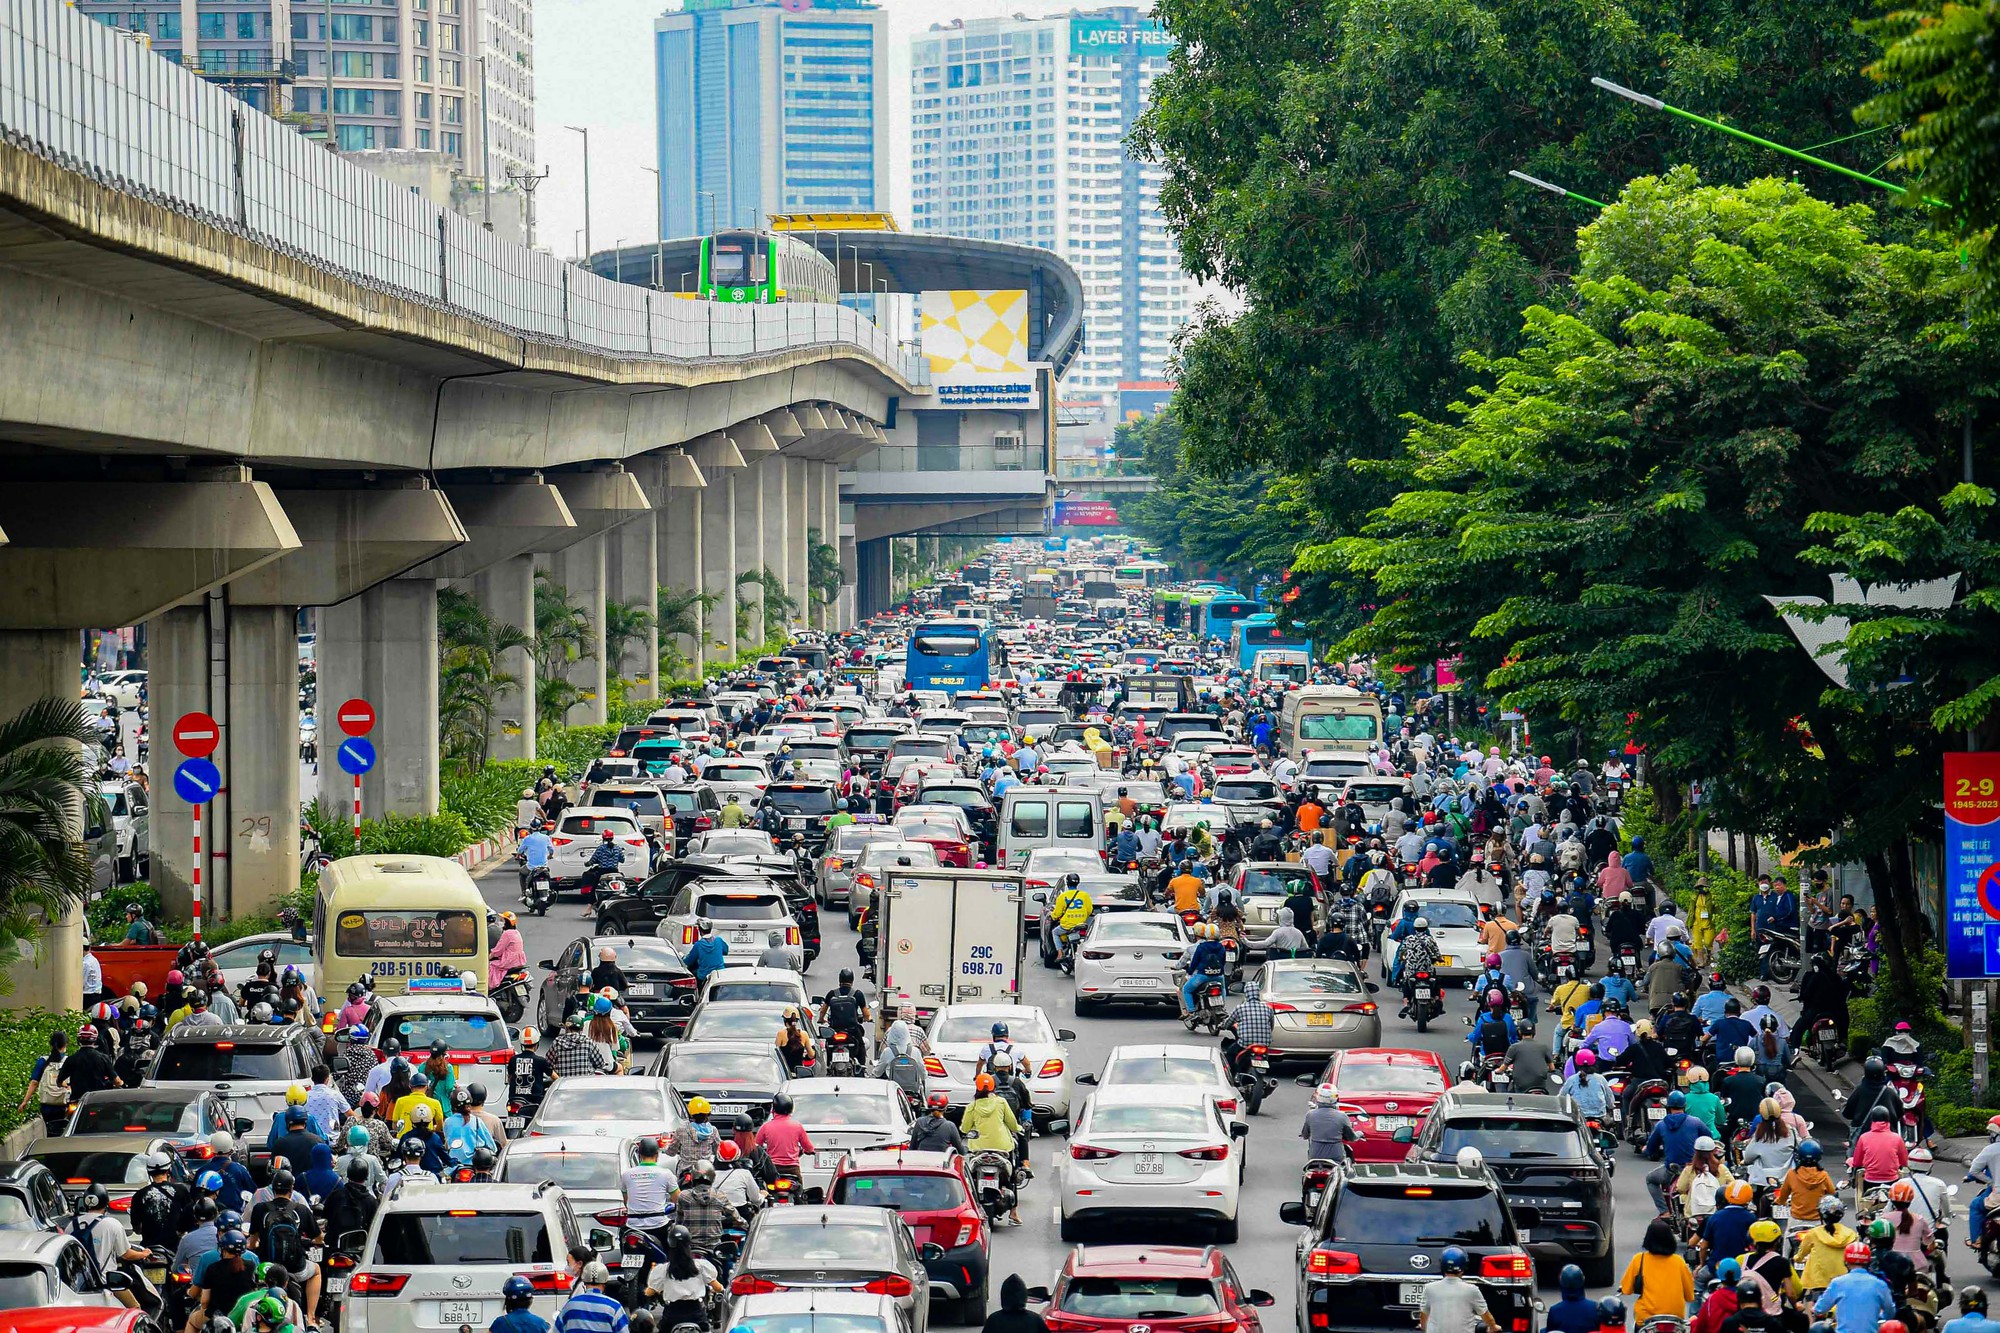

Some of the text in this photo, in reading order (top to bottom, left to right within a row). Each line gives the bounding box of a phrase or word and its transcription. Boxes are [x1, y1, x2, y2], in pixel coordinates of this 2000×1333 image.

[1078, 30, 1127, 45] LAYER
[1956, 778, 1994, 796] 2-9
[1952, 800, 1998, 809] 1945-2023
[415, 940, 429, 948] Tour
[430, 940, 443, 948] Bus
[970, 946, 993, 959] 29C
[962, 962, 1003, 975] 698.70
[1141, 1154, 1156, 1163] 30F
[452, 1303, 470, 1312] 34A
[444, 1313, 477, 1322] 688.17
